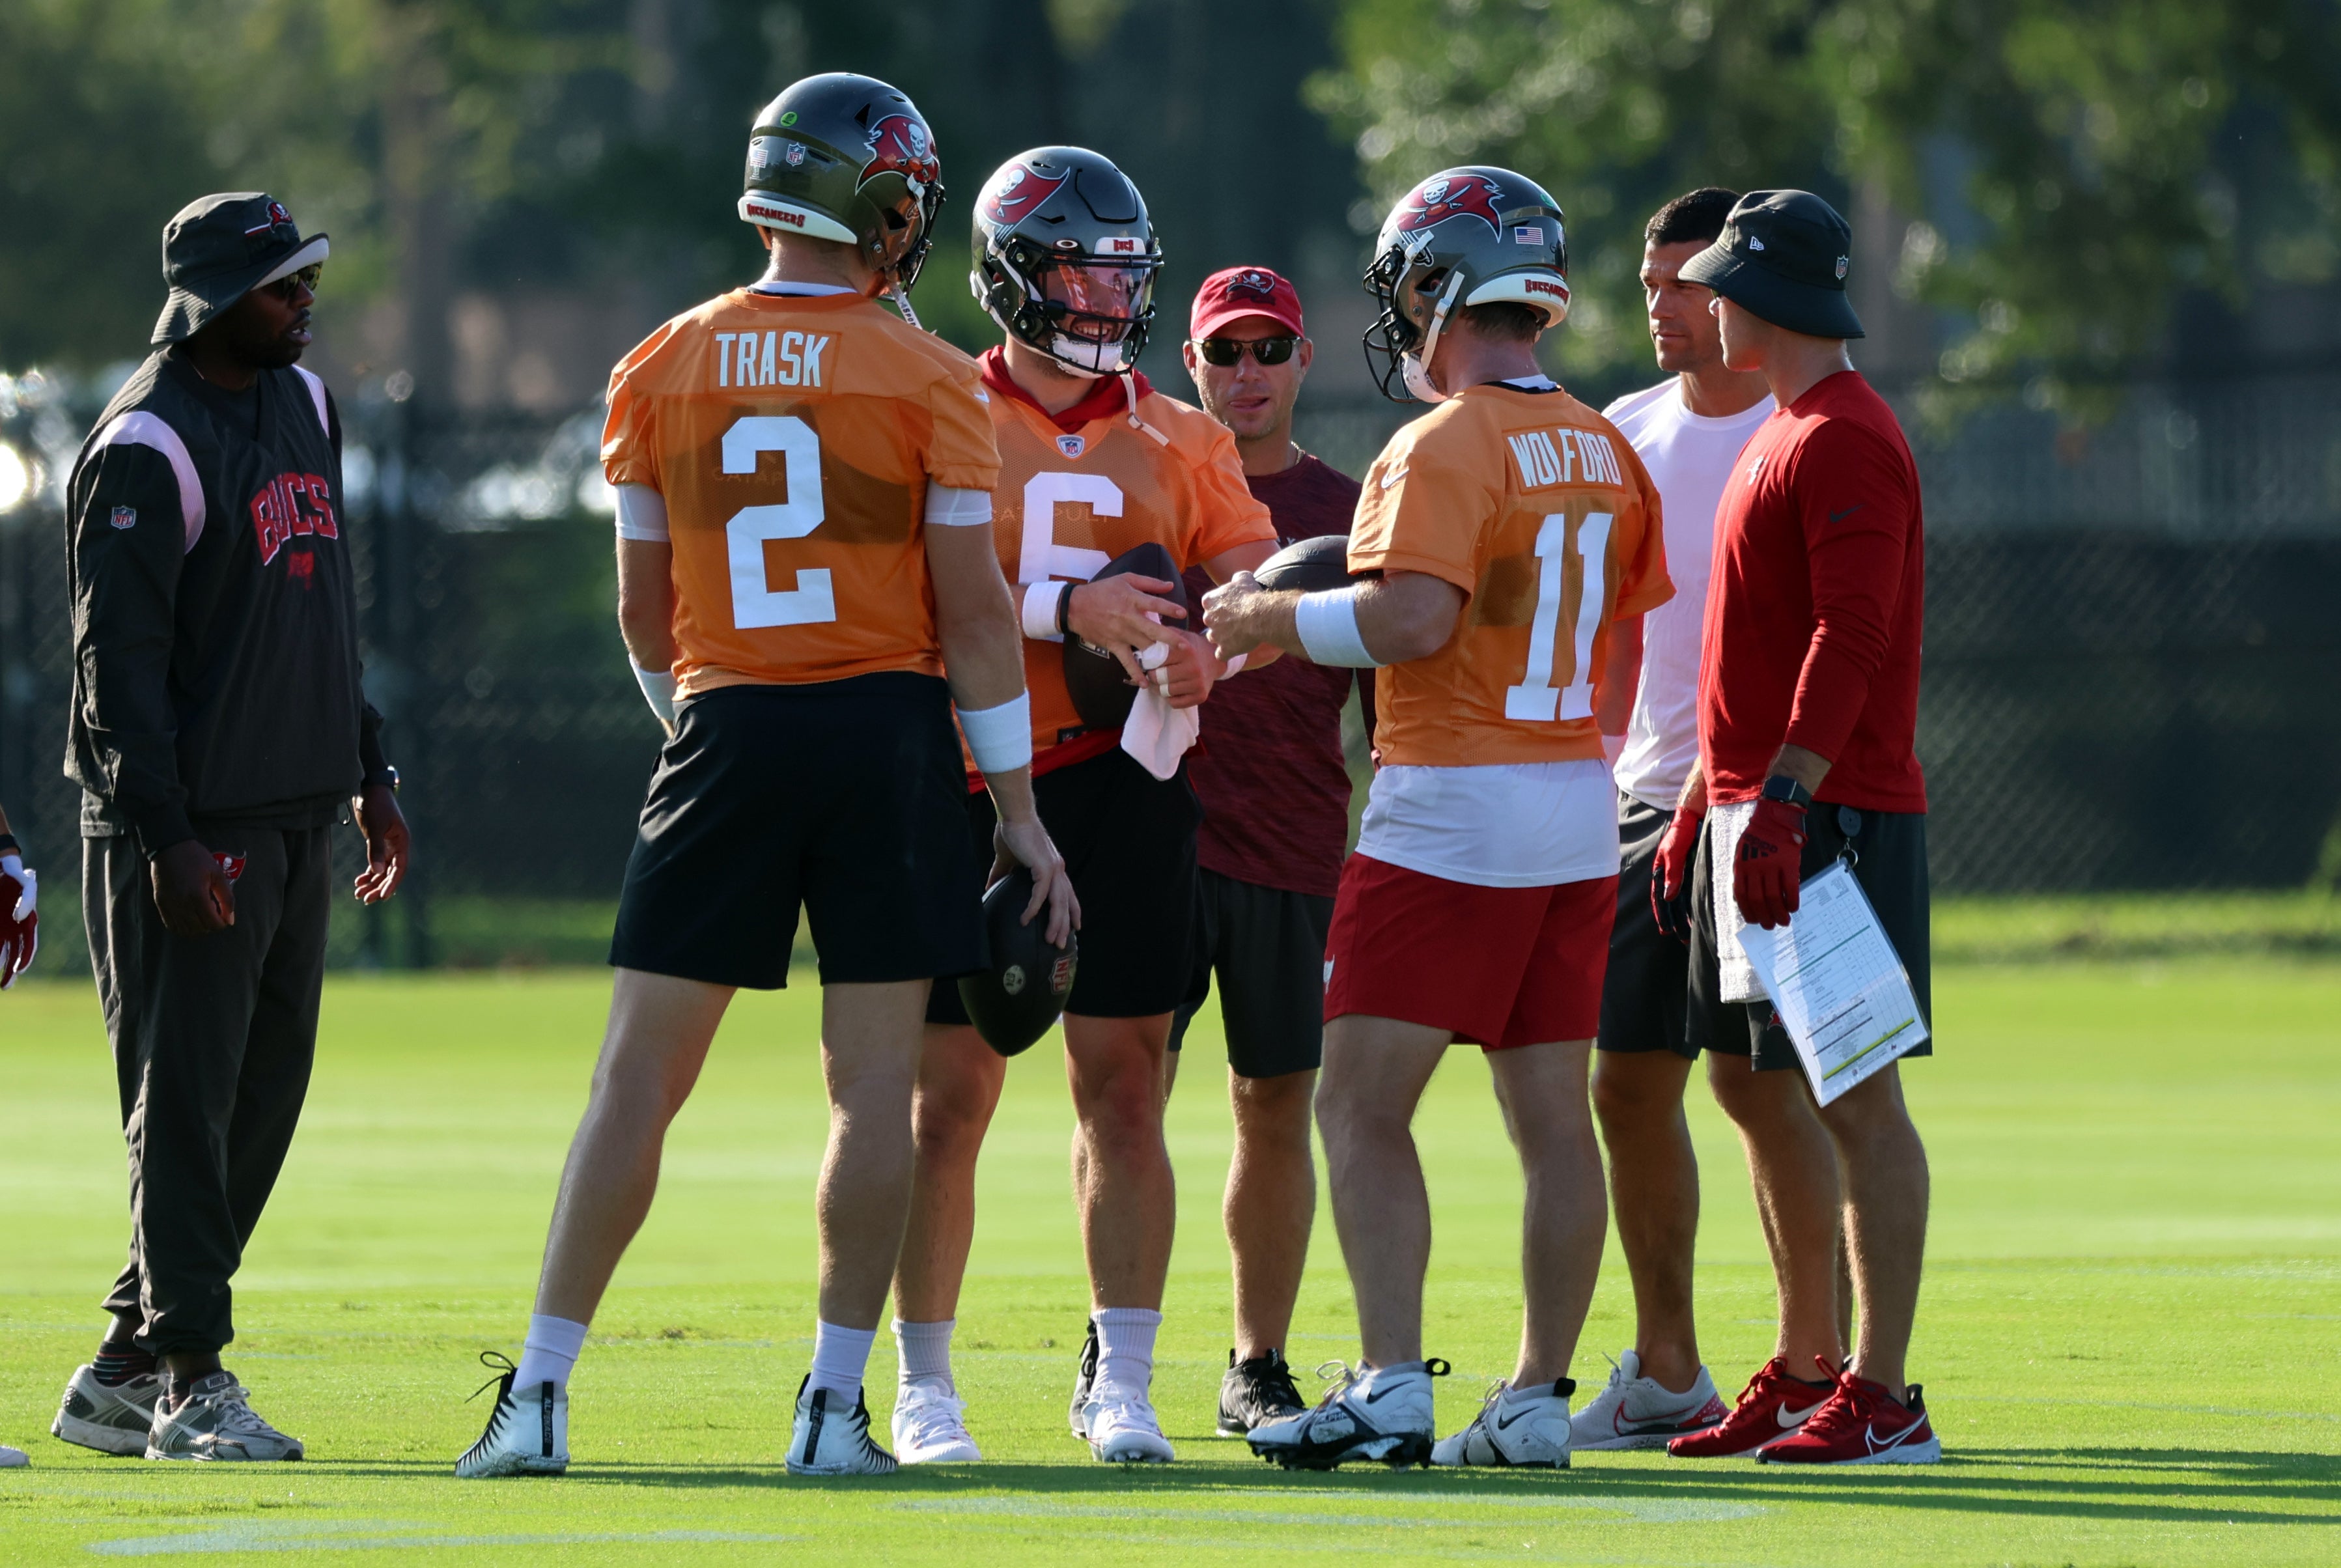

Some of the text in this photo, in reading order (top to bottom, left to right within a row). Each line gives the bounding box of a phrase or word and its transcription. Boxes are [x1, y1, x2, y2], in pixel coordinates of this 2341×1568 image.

[789, 151, 800, 163] NFL
[1113, 239, 1134, 253] BUCS
[715, 331, 829, 387] TRASK
[1507, 428, 1622, 488] WOLFORD
[114, 514, 133, 526] NFL
[250, 472, 338, 567] BUCS
[722, 416, 837, 630] 2
[1018, 471, 1124, 642] 6
[1505, 512, 1614, 721] 11
[1054, 959, 1070, 992] NFL
